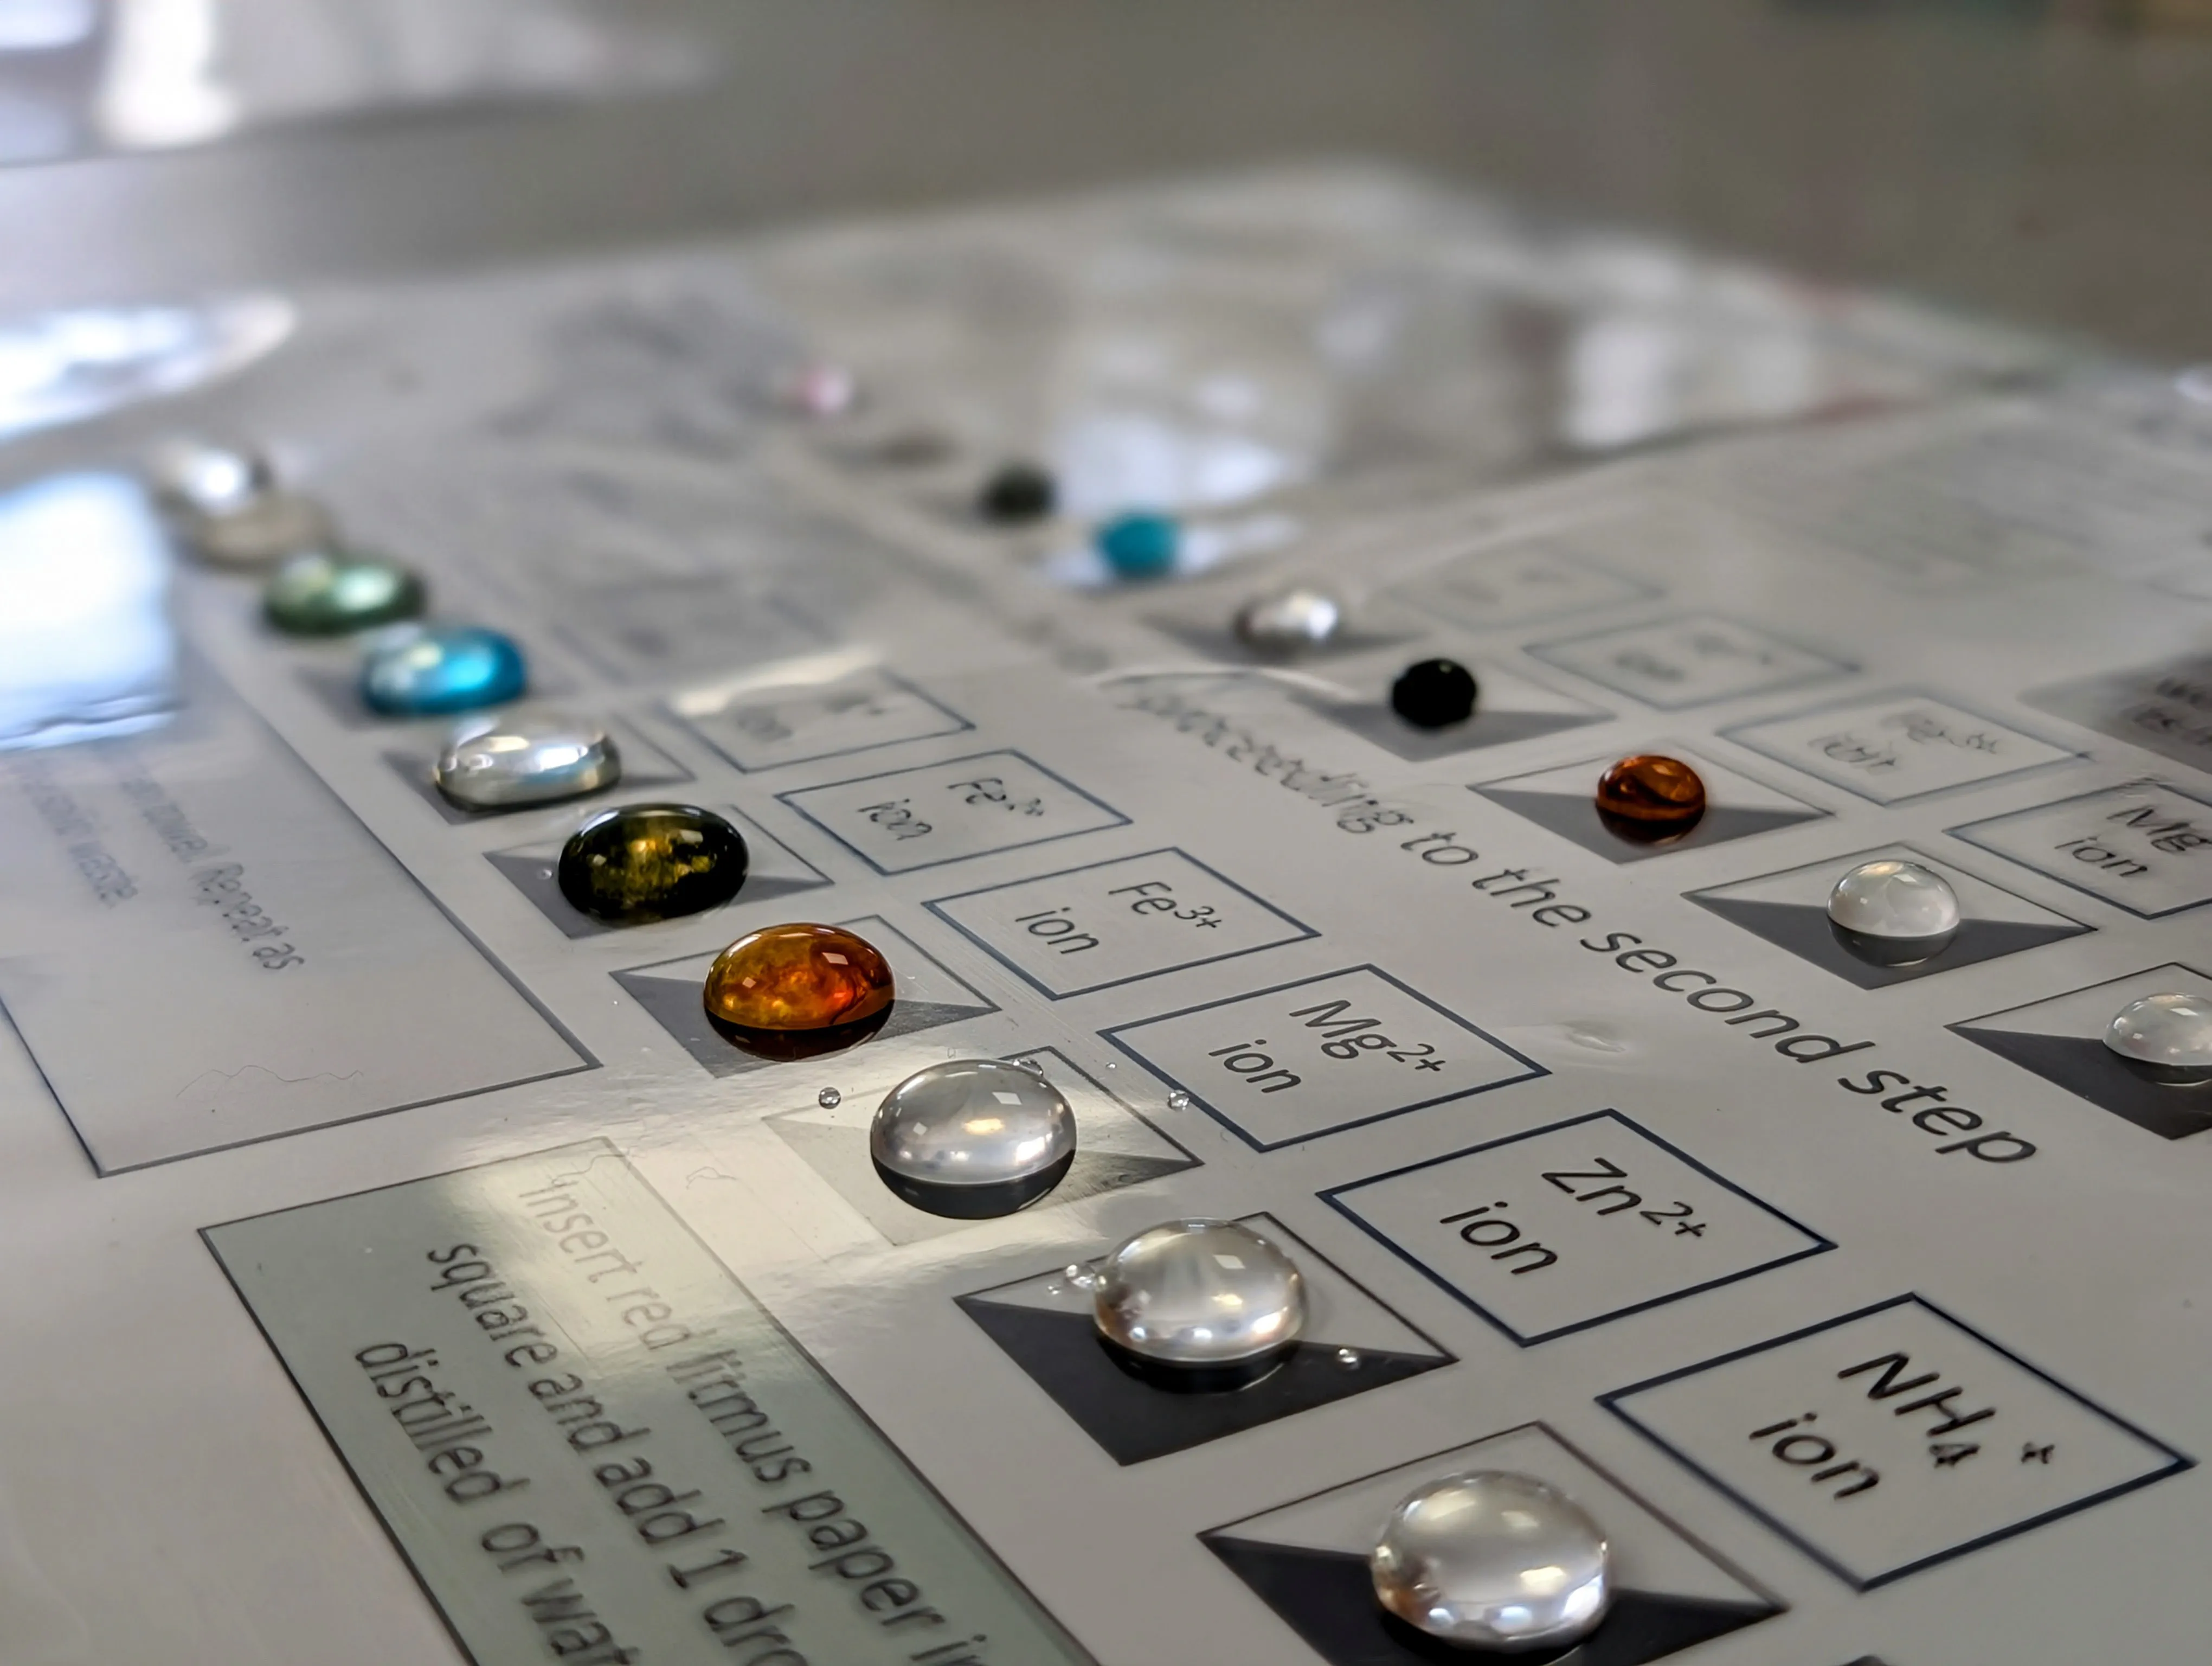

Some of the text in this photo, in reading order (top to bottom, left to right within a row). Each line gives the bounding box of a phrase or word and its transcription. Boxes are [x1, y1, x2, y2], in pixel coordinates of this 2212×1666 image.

[2054, 836, 2148, 877] ion
[252, 942, 305, 970] as
[1015, 907, 1099, 954] ion
[1401, 831, 1480, 866] to
[1472, 868, 1592, 928] the
[1580, 927, 1876, 1065] second
[1837, 1068, 2037, 1164] step
[1208, 1039, 1302, 1093] ion
[1439, 1201, 1558, 1275] ion
[426, 1242, 558, 1368] square
[528, 1373, 652, 1452] and
[594, 1457, 725, 1545] add
[667, 1548, 749, 1590] 1
[606, 1286, 717, 1350] red
[666, 1348, 813, 1483] litmus
[761, 1489, 946, 1626] paper
[1749, 1411, 1881, 1501] ion
[355, 1342, 531, 1507] distilled
[479, 1522, 586, 1573] of
